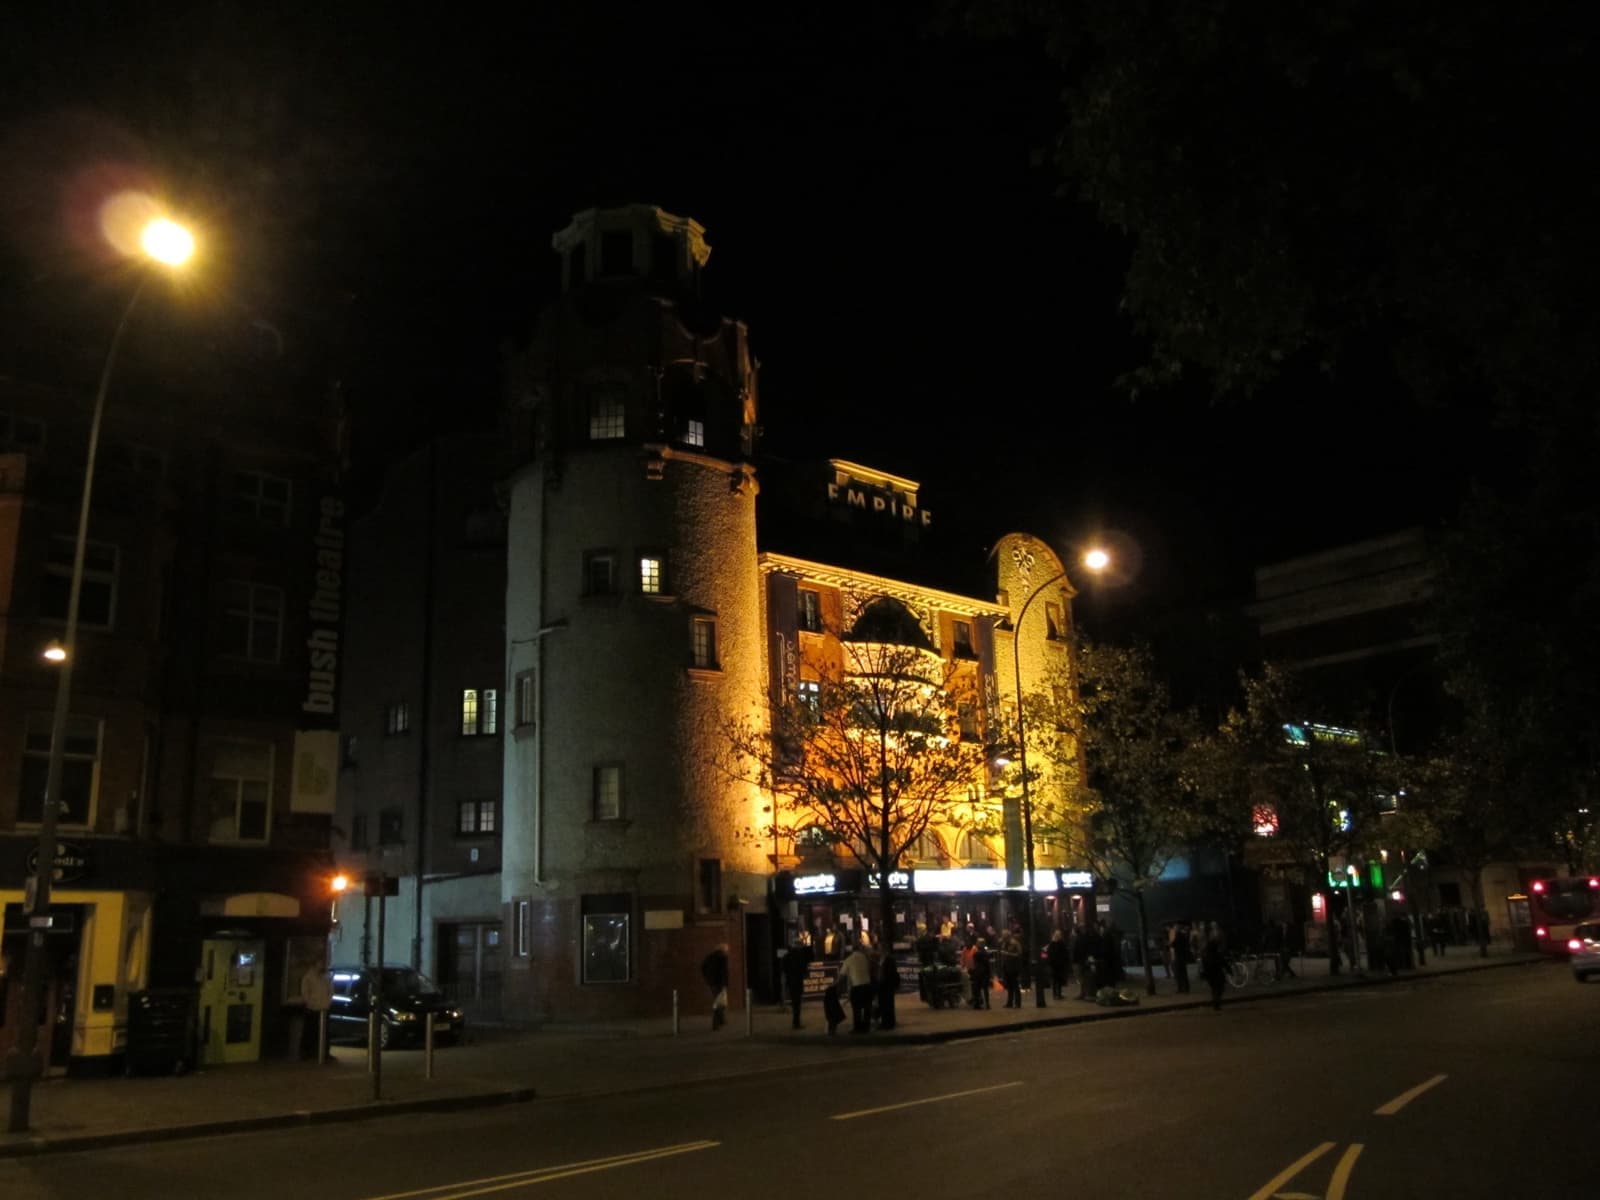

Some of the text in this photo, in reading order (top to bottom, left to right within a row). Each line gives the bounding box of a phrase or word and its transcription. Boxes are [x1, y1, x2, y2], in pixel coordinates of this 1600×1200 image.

[826, 482, 933, 528] EMPIRE
[301, 495, 345, 715] bush theatre
